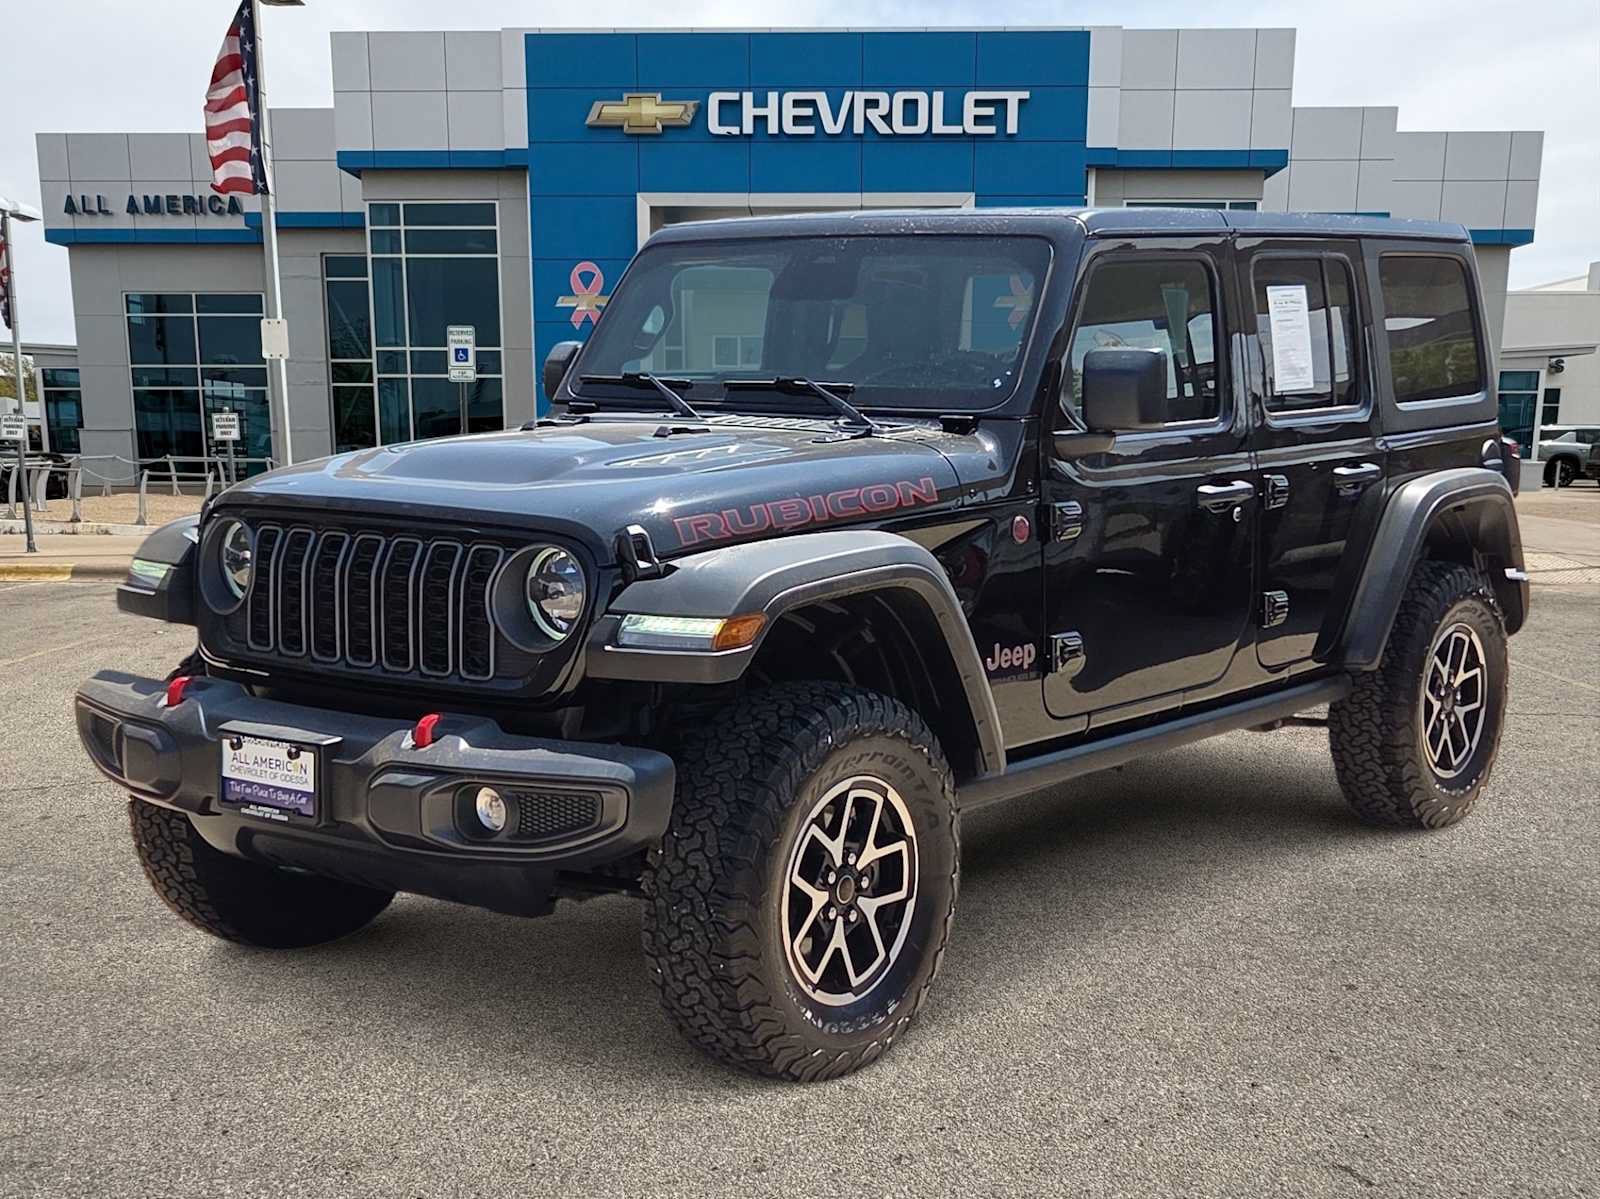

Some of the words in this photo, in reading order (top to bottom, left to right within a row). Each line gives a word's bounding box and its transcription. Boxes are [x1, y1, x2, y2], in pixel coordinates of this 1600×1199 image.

[708, 91, 1030, 135] CHEVROLET
[64, 195, 112, 216] ALL
[673, 477, 938, 547] RUBICON
[986, 642, 1036, 671] Jeep
[231, 752, 250, 765] ALL
[230, 764, 268, 779] CHEVROLET
[269, 771, 279, 780] OF
[280, 773, 309, 785] ODESSA
